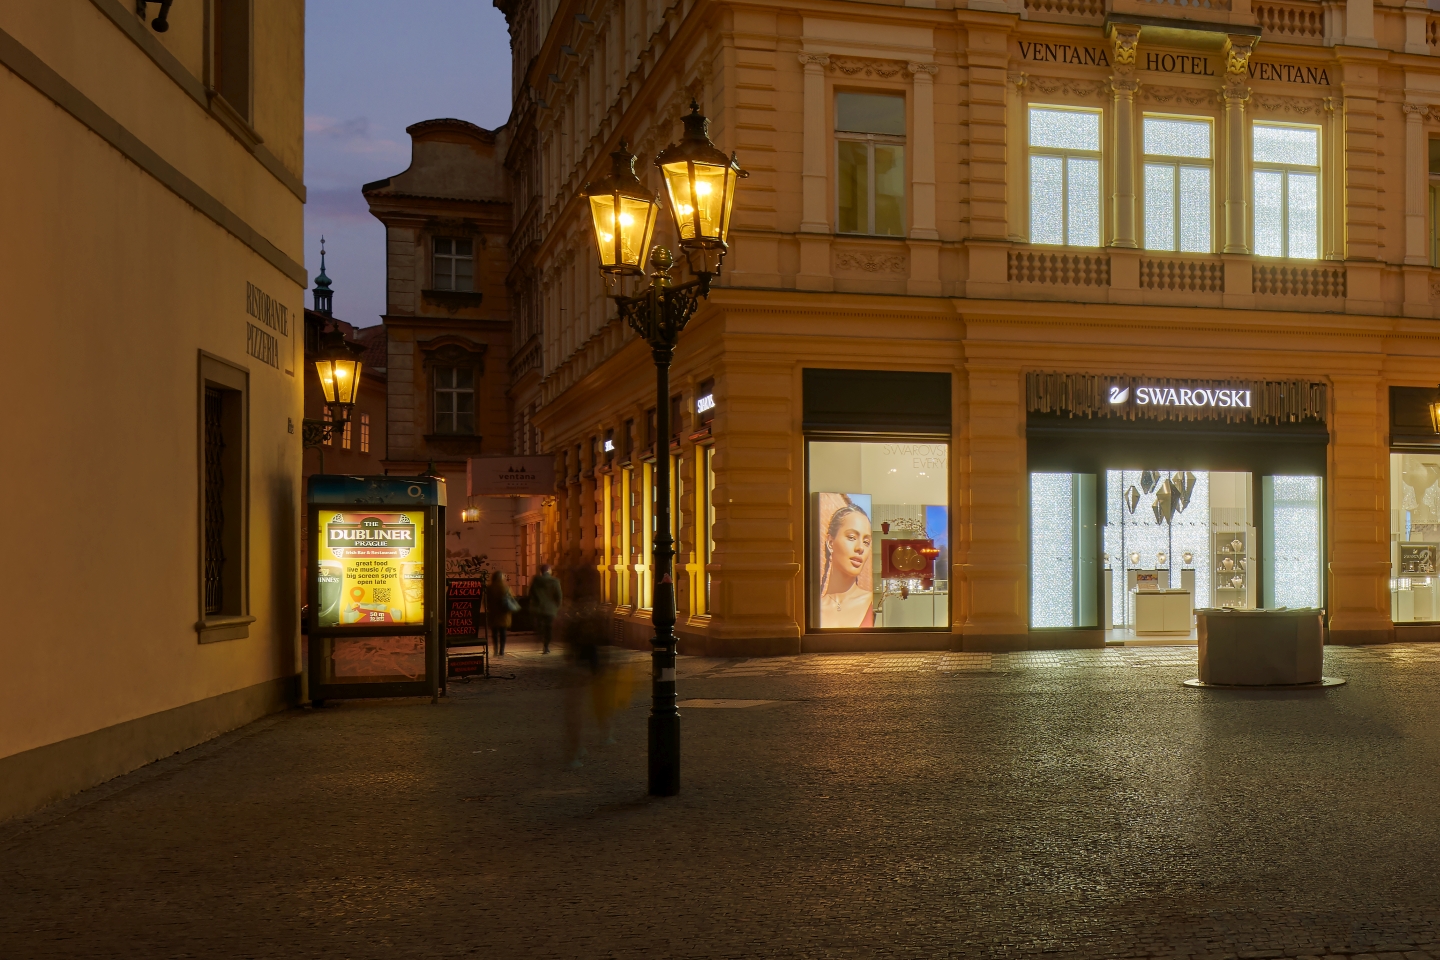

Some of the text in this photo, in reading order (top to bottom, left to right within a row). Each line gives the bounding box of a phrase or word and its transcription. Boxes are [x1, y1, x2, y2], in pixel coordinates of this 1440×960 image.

[1018, 41, 1330, 86] VENTANA HOTEL VENTANA
[246, 280, 289, 338] RISTORANTE
[246, 321, 280, 370] PIZZERIA
[1136, 387, 1251, 408] SWAROVSKI
[883, 443, 948, 457] SWAROVSK
[913, 457, 947, 468] EVERY
[407, 485, 425, 500] O2
[330, 529, 412, 540] DUBLINER
[451, 580, 482, 589] PIZZERIA
[449, 588, 481, 596] LA SCALA
[451, 601, 473, 609] PIZZA
[450, 610, 472, 618] PASTA
[448, 618, 473, 627] STEAKS
[446, 626, 477, 635] DESSERTS
